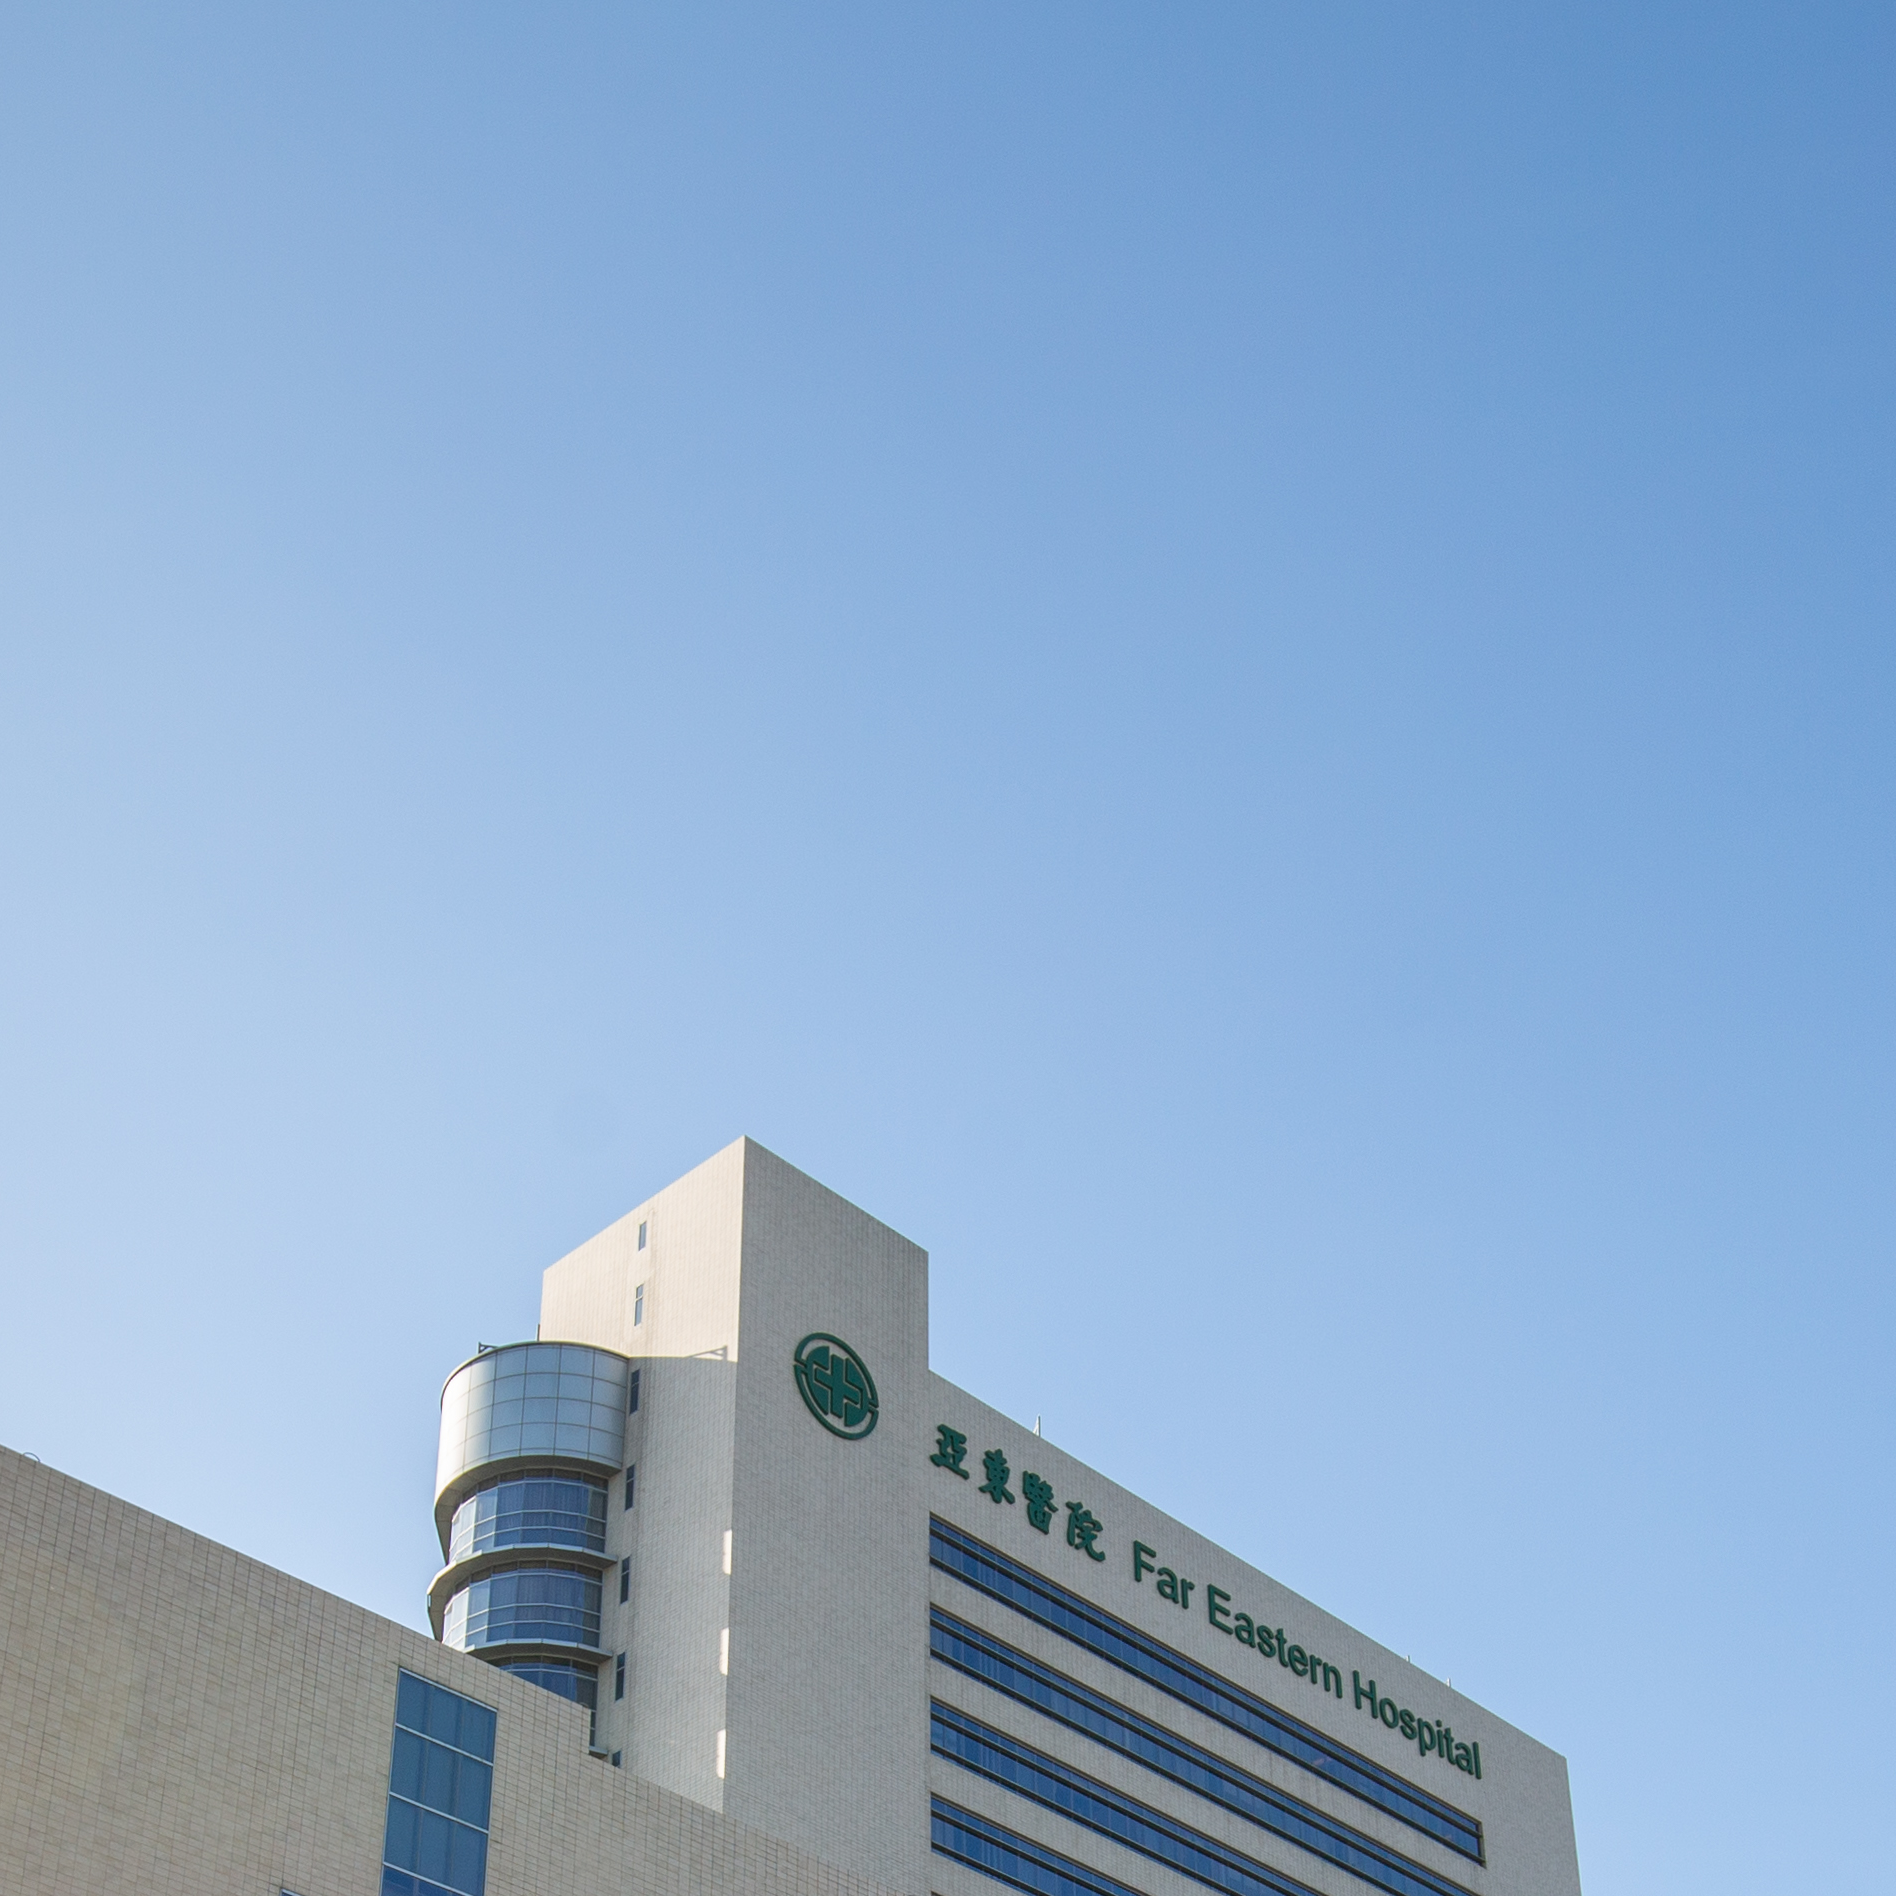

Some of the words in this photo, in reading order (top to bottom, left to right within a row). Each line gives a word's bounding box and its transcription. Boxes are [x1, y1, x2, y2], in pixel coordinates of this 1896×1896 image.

[930, 1423, 1106, 1562] 亞東醫院
[1133, 1540, 1195, 1609] Far
[1207, 1583, 1343, 1699] Eastern
[1352, 1669, 1483, 1780] Hospital
